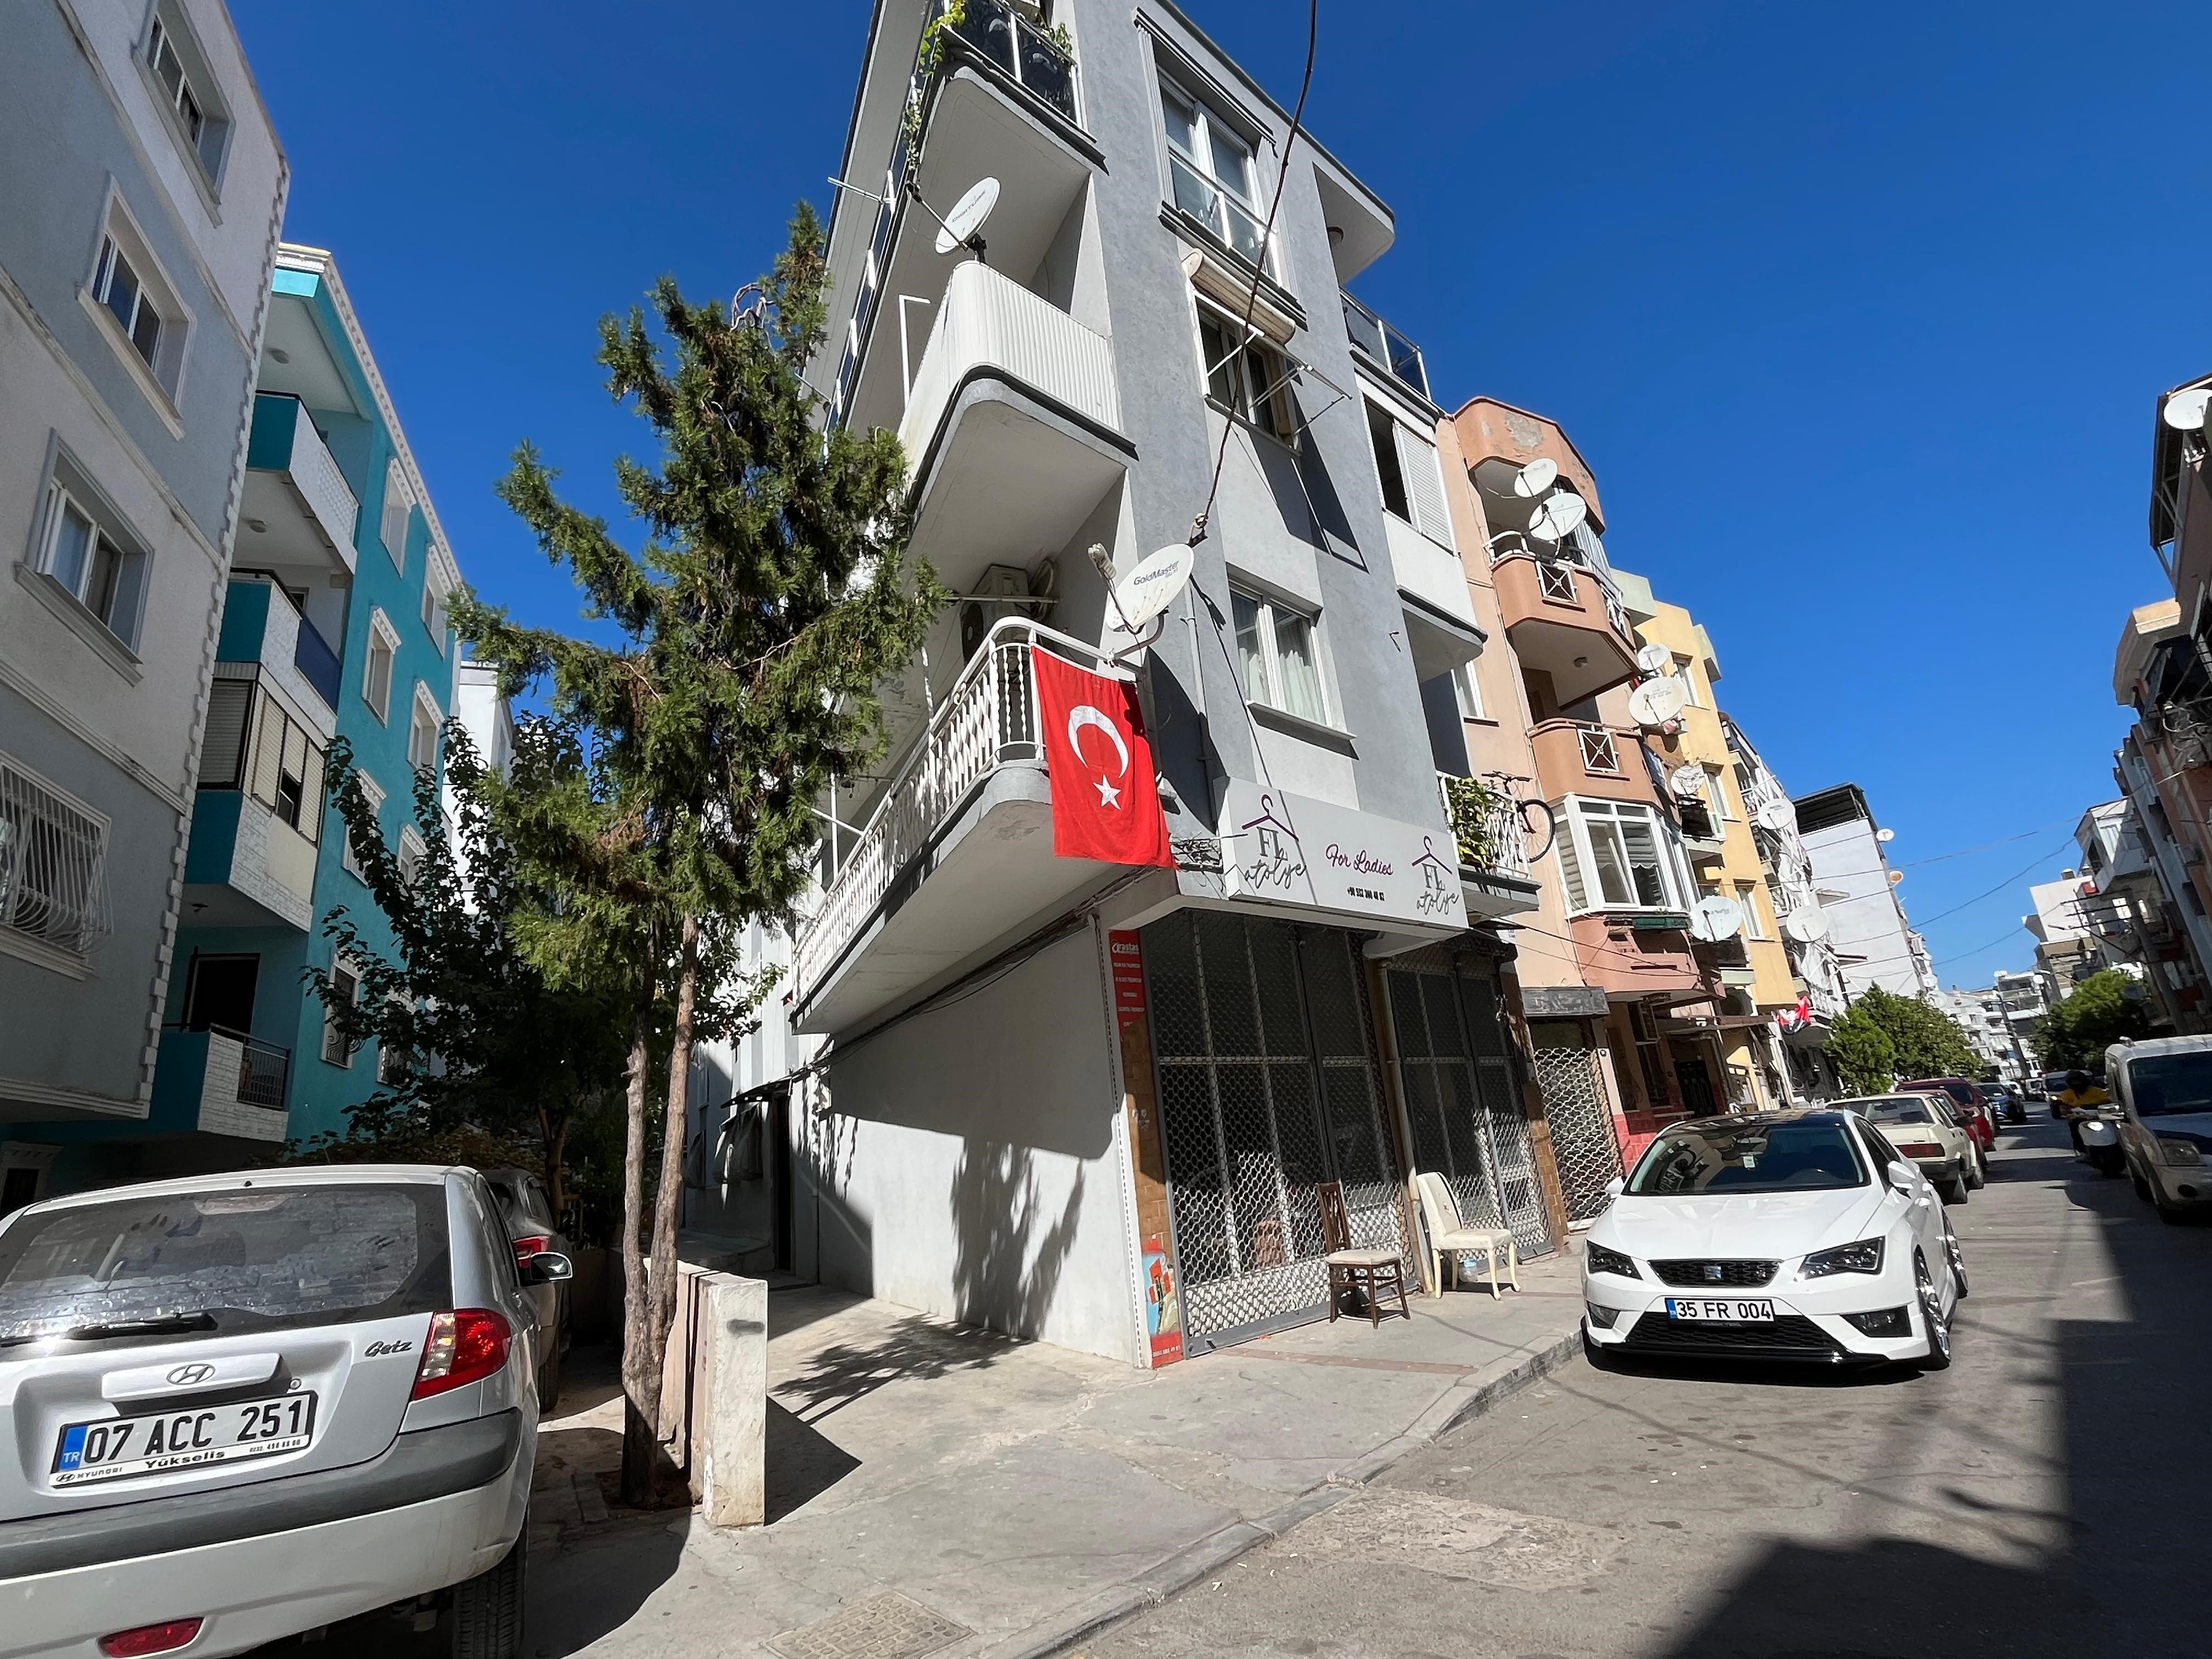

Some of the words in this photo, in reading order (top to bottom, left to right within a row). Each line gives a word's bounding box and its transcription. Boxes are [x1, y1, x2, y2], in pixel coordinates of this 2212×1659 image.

[1133, 560, 1180, 585] GoldMaster
[1325, 843, 1351, 867] For
[1353, 849, 1393, 876] Ladies
[1677, 1301, 1697, 1318] 35
[1703, 1302, 1731, 1319] FR
[1737, 1302, 1771, 1319] 004
[364, 1340, 413, 1357] Getz
[84, 1423, 134, 1463] 07
[144, 1412, 216, 1455] ACC
[236, 1400, 302, 1442] 251
[62, 1451, 81, 1464] TR
